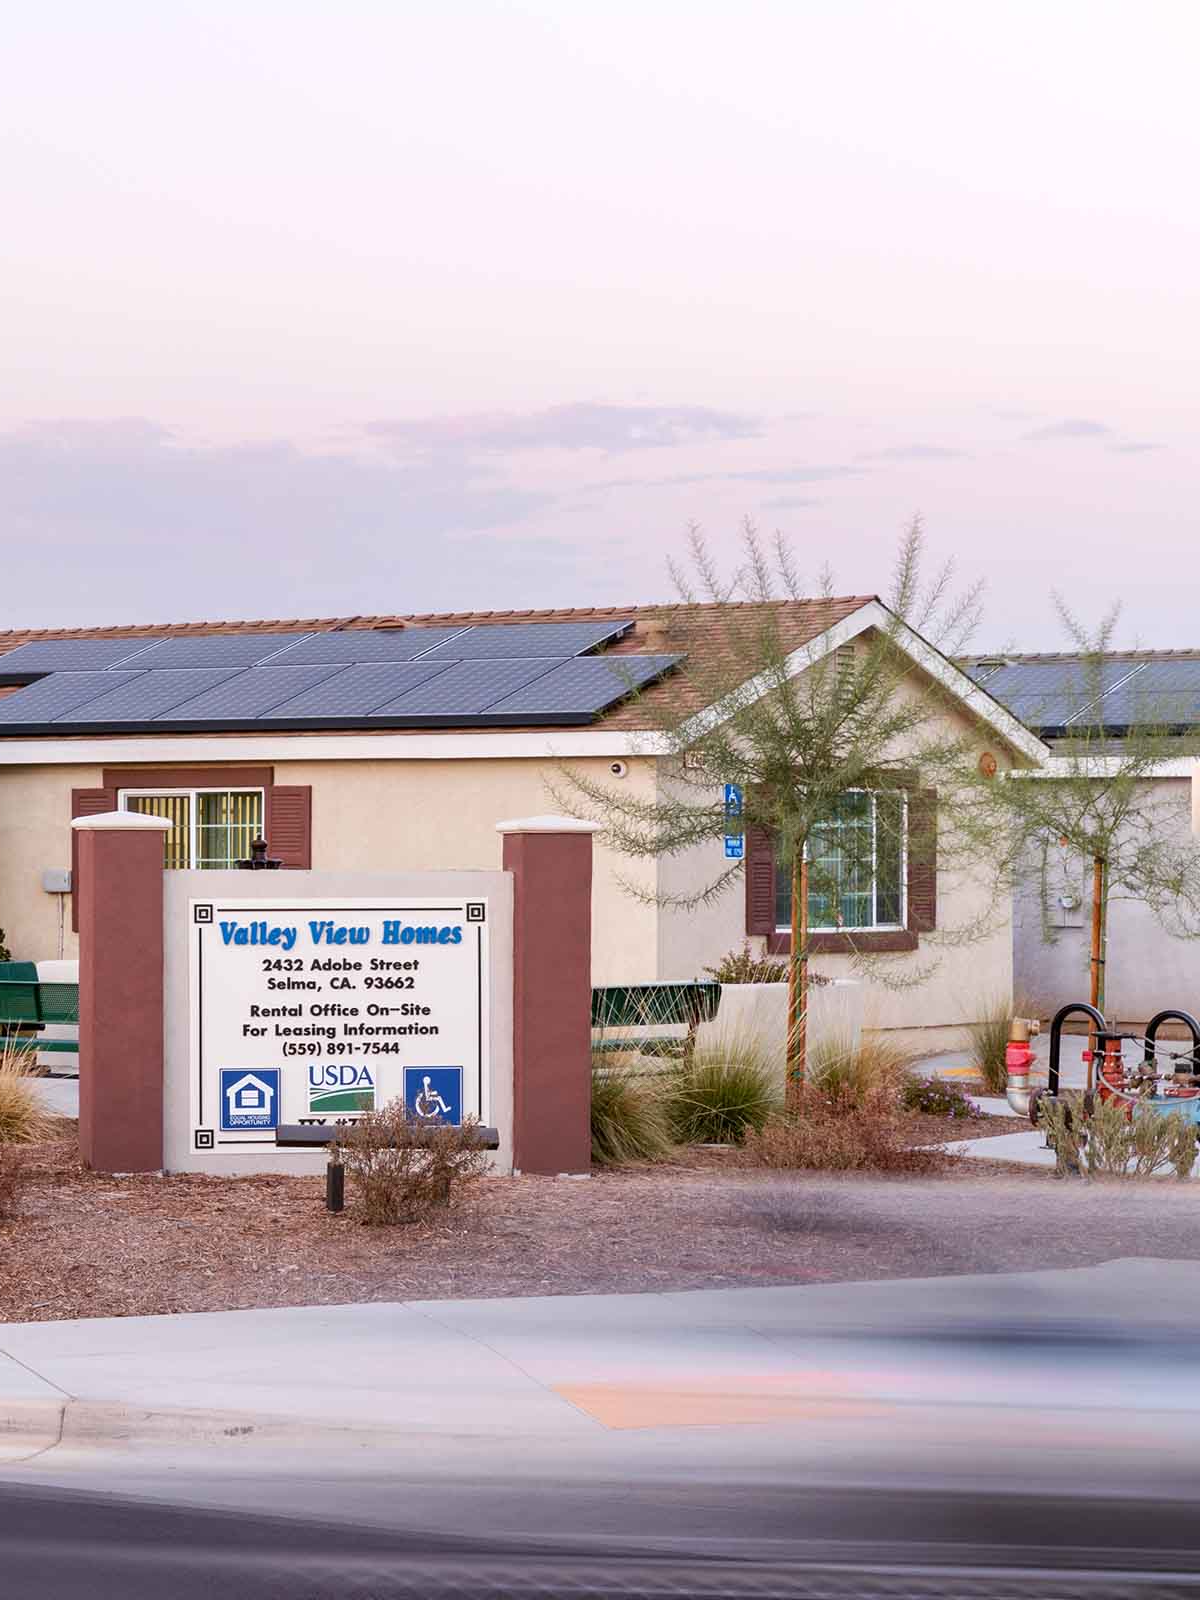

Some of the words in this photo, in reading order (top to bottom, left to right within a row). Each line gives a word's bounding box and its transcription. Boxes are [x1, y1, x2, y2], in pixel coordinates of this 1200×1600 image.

[219, 921, 297, 951] Valley
[308, 921, 370, 945] View
[382, 920, 463, 945] Homes
[262, 958, 304, 972] 2432
[310, 957, 363, 972] Adobe
[369, 958, 420, 971] Street
[267, 976, 322, 992] Selma,
[329, 977, 357, 990] CA.
[363, 976, 415, 990] 93662
[250, 1004, 303, 1017] Rental
[309, 1003, 360, 1017] Office
[366, 1003, 432, 1017] On-Site
[242, 1023, 268, 1037] For
[274, 1023, 337, 1039] Leasing
[343, 1022, 439, 1036] Information
[282, 1042, 322, 1057] (559)
[326, 1041, 401, 1056] 891-7544
[308, 1064, 375, 1086] USDA
